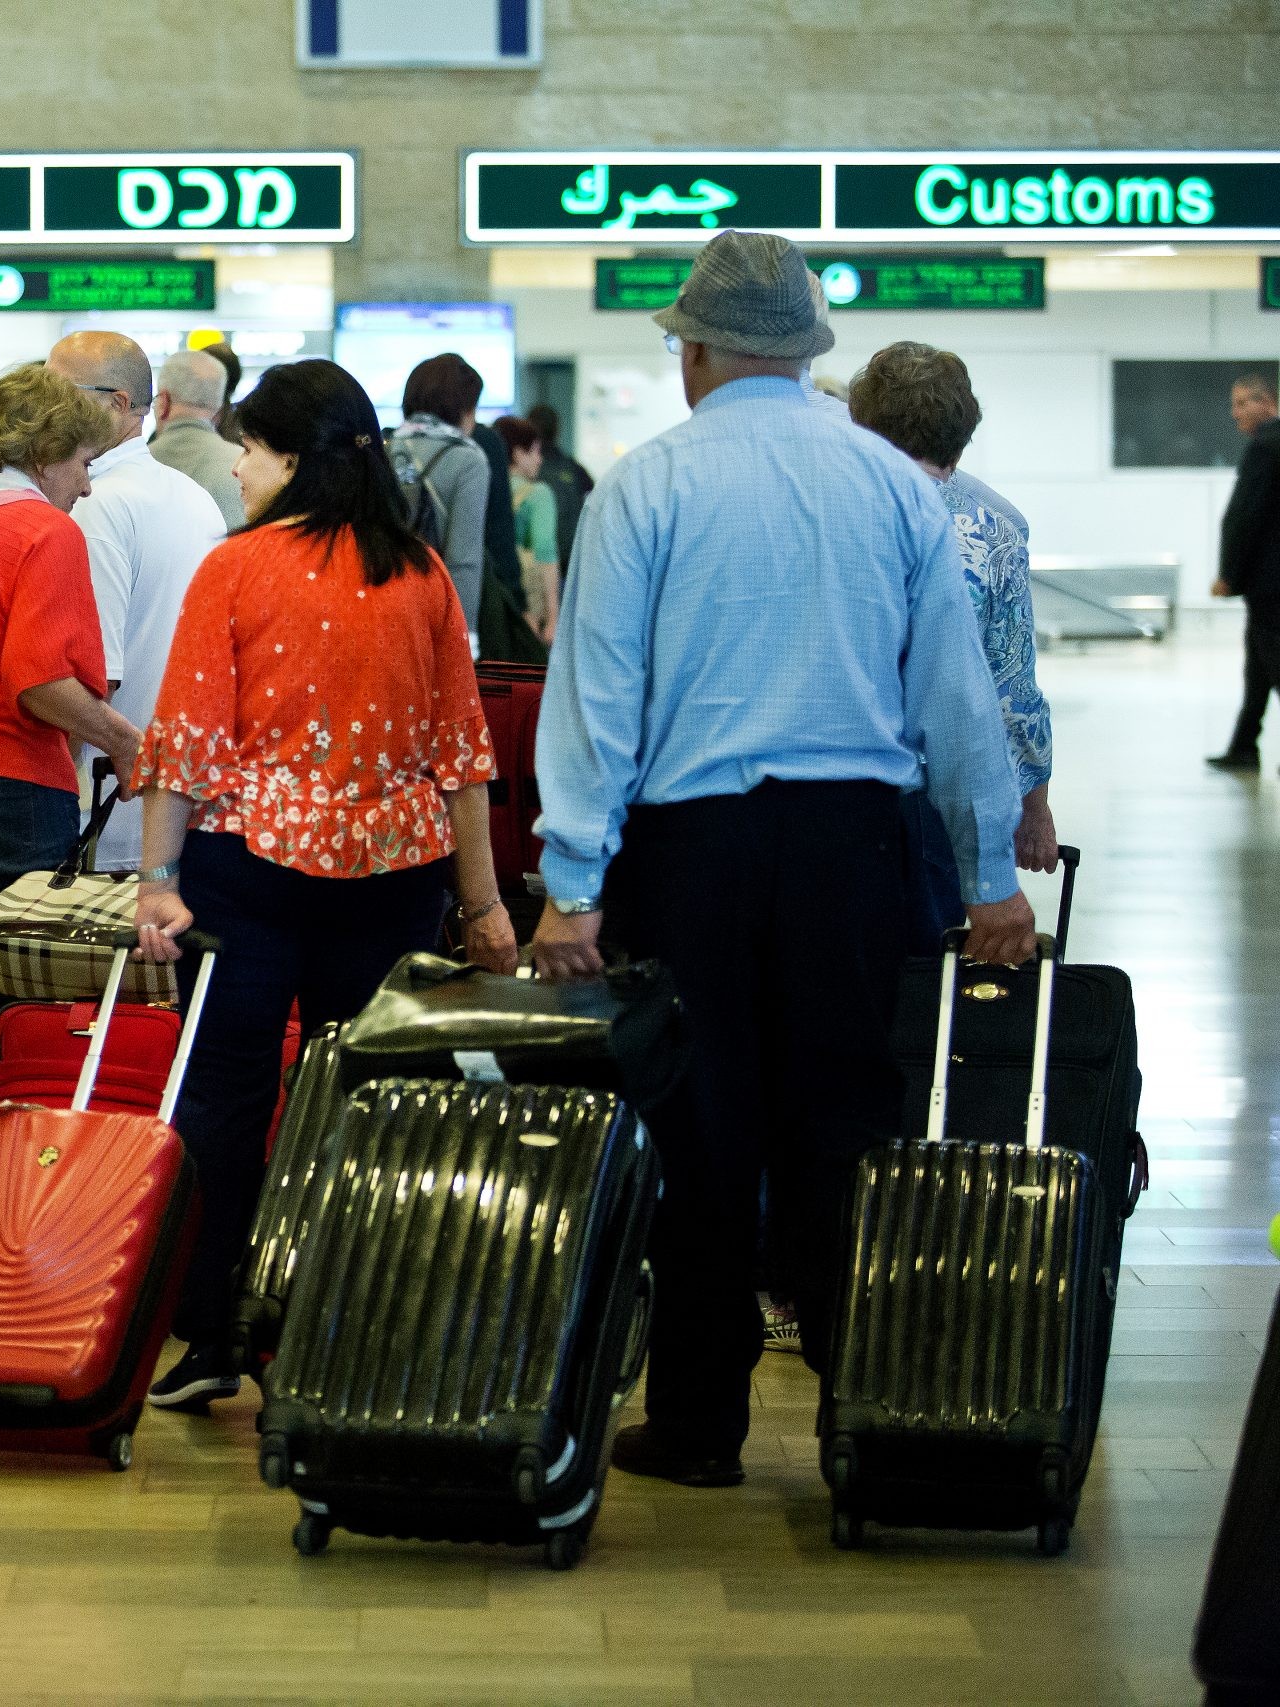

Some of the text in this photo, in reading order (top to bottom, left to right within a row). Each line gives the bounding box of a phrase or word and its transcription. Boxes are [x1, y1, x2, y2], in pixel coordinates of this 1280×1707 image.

[117, 168, 297, 228] מכס
[560, 165, 739, 227] جمرك
[914, 165, 1216, 226] Customs
